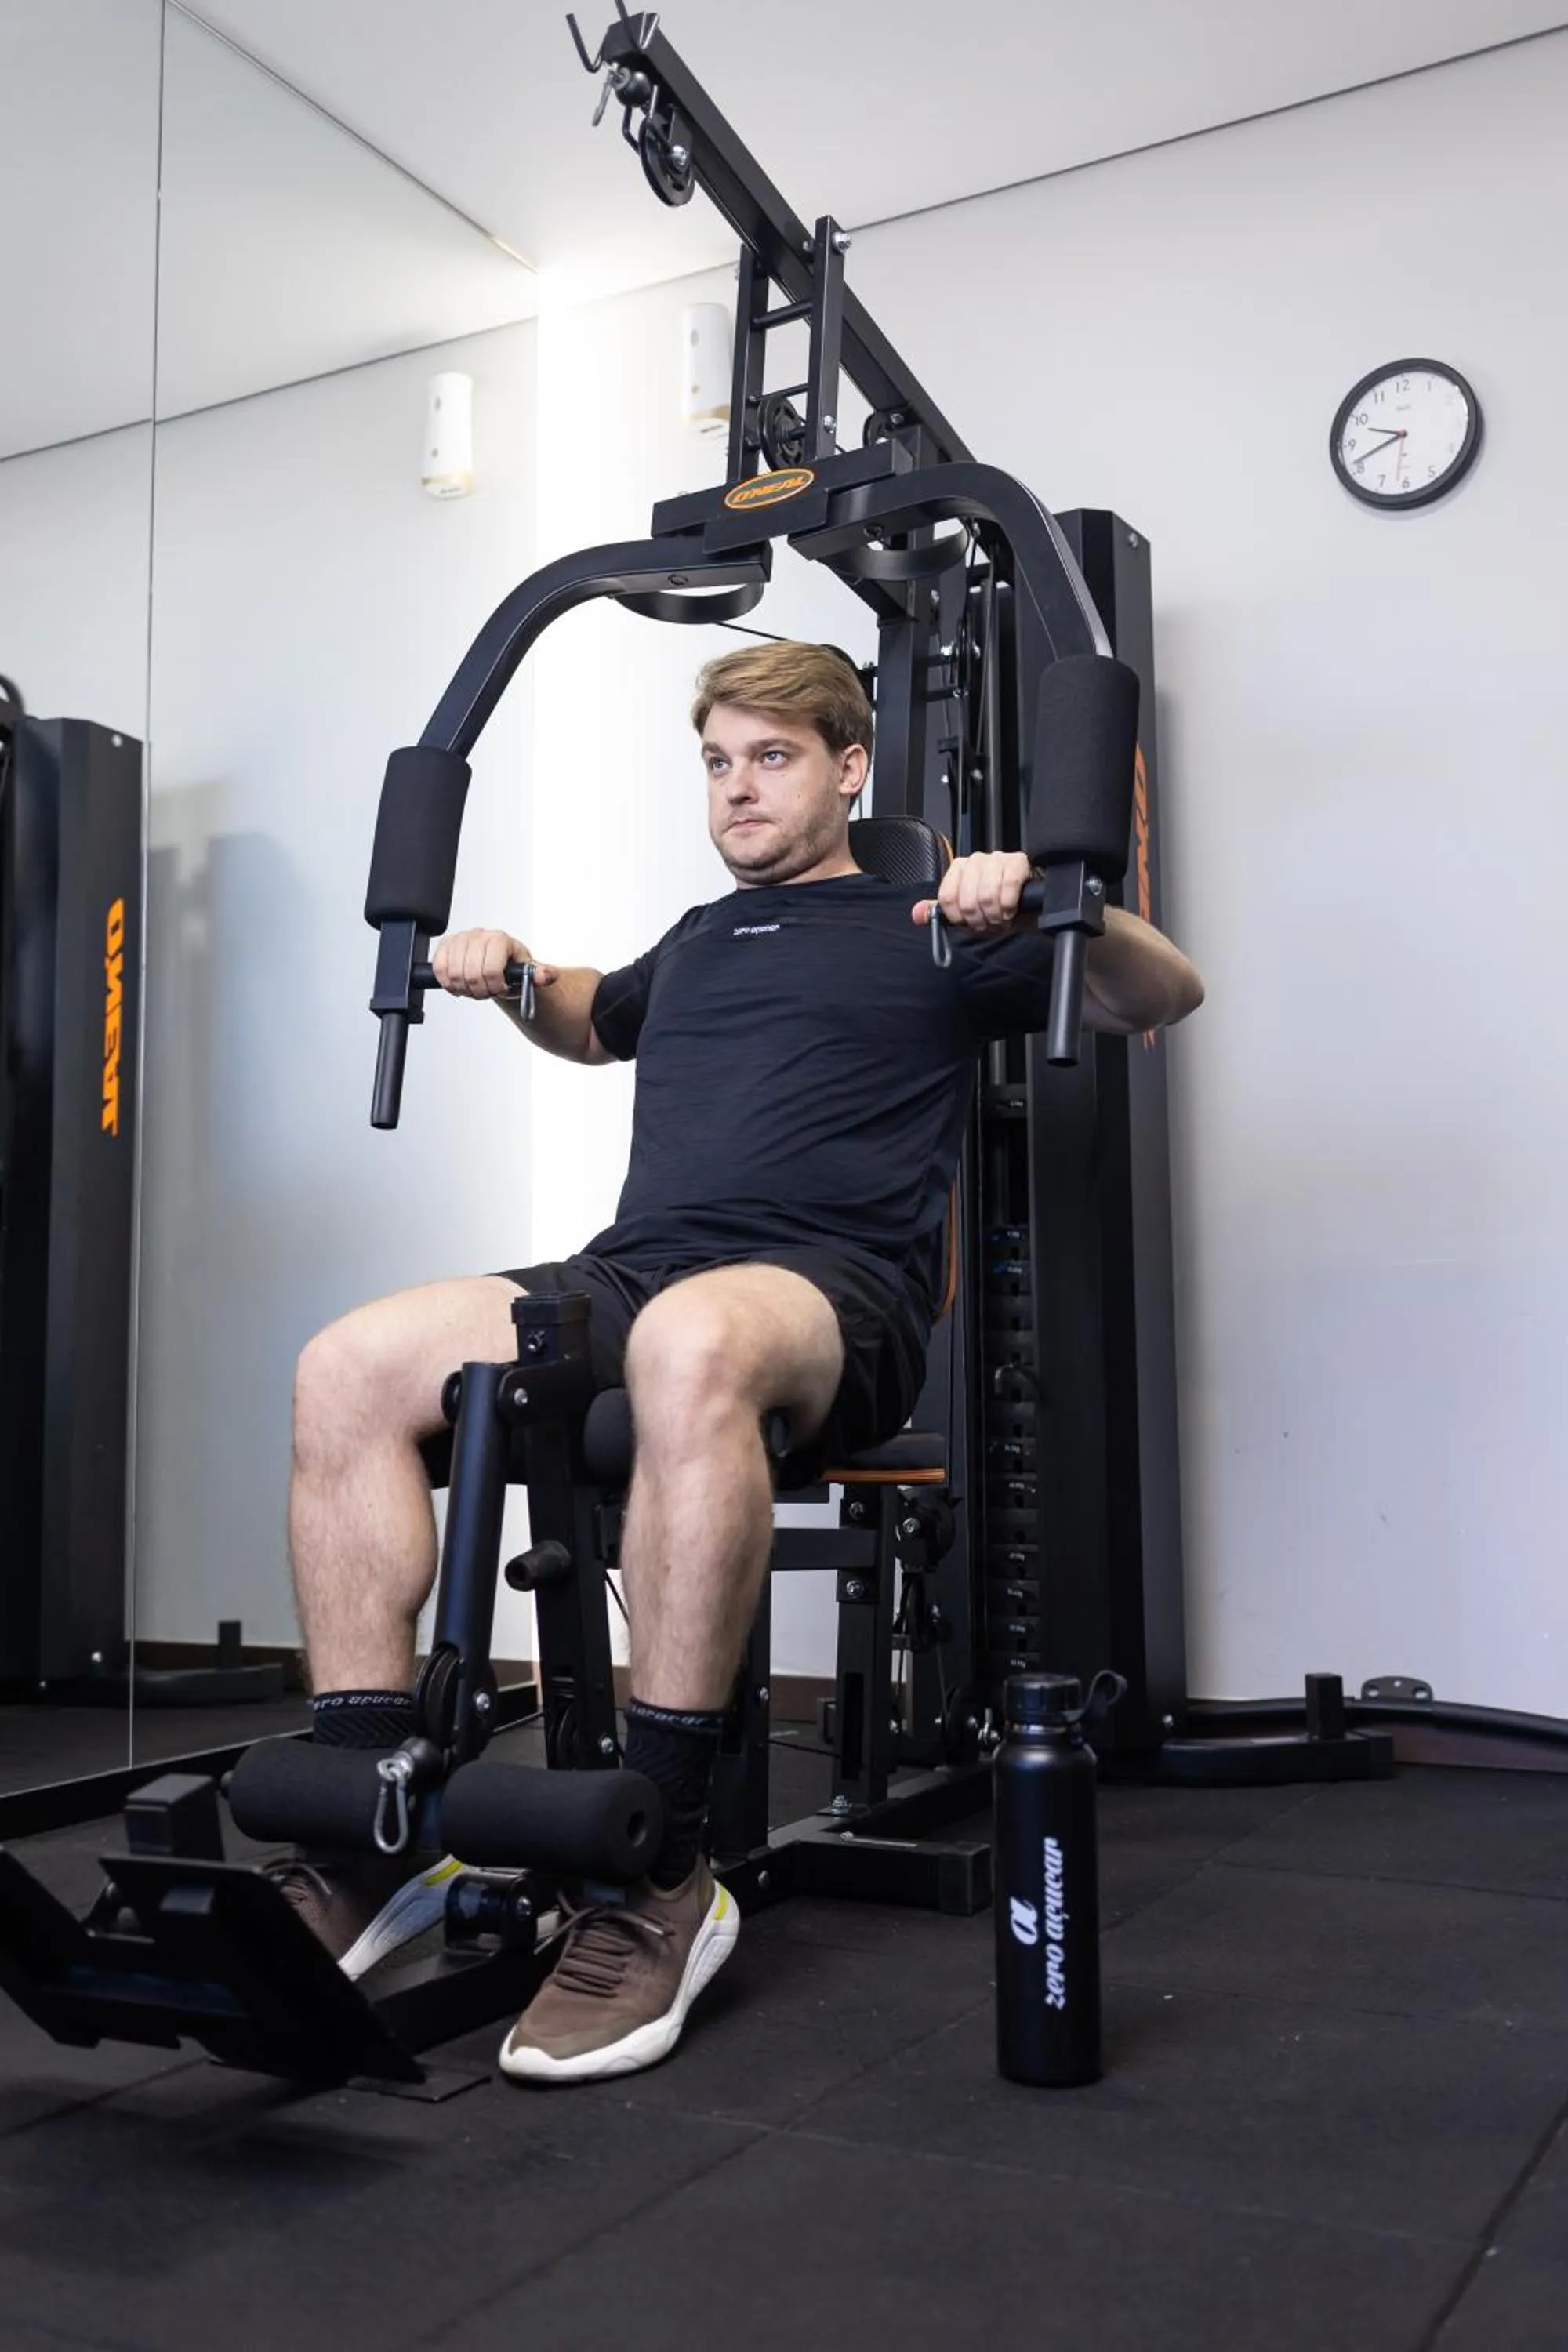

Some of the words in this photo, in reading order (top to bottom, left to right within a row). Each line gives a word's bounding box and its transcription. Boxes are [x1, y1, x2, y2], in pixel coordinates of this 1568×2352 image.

[1396, 379, 1410, 393] 12
[1374, 391, 1385, 404] 11
[1356, 413, 1368, 426] 10
[1348, 439, 1356, 451] 9
[1356, 463, 1365, 474] 8
[1428, 465, 1436, 477] 5
[1377, 474, 1387, 487] 7
[1402, 477, 1410, 488] 6
[1043, 1836, 1069, 1941] açucar
[1044, 1944, 1067, 2009] zero
